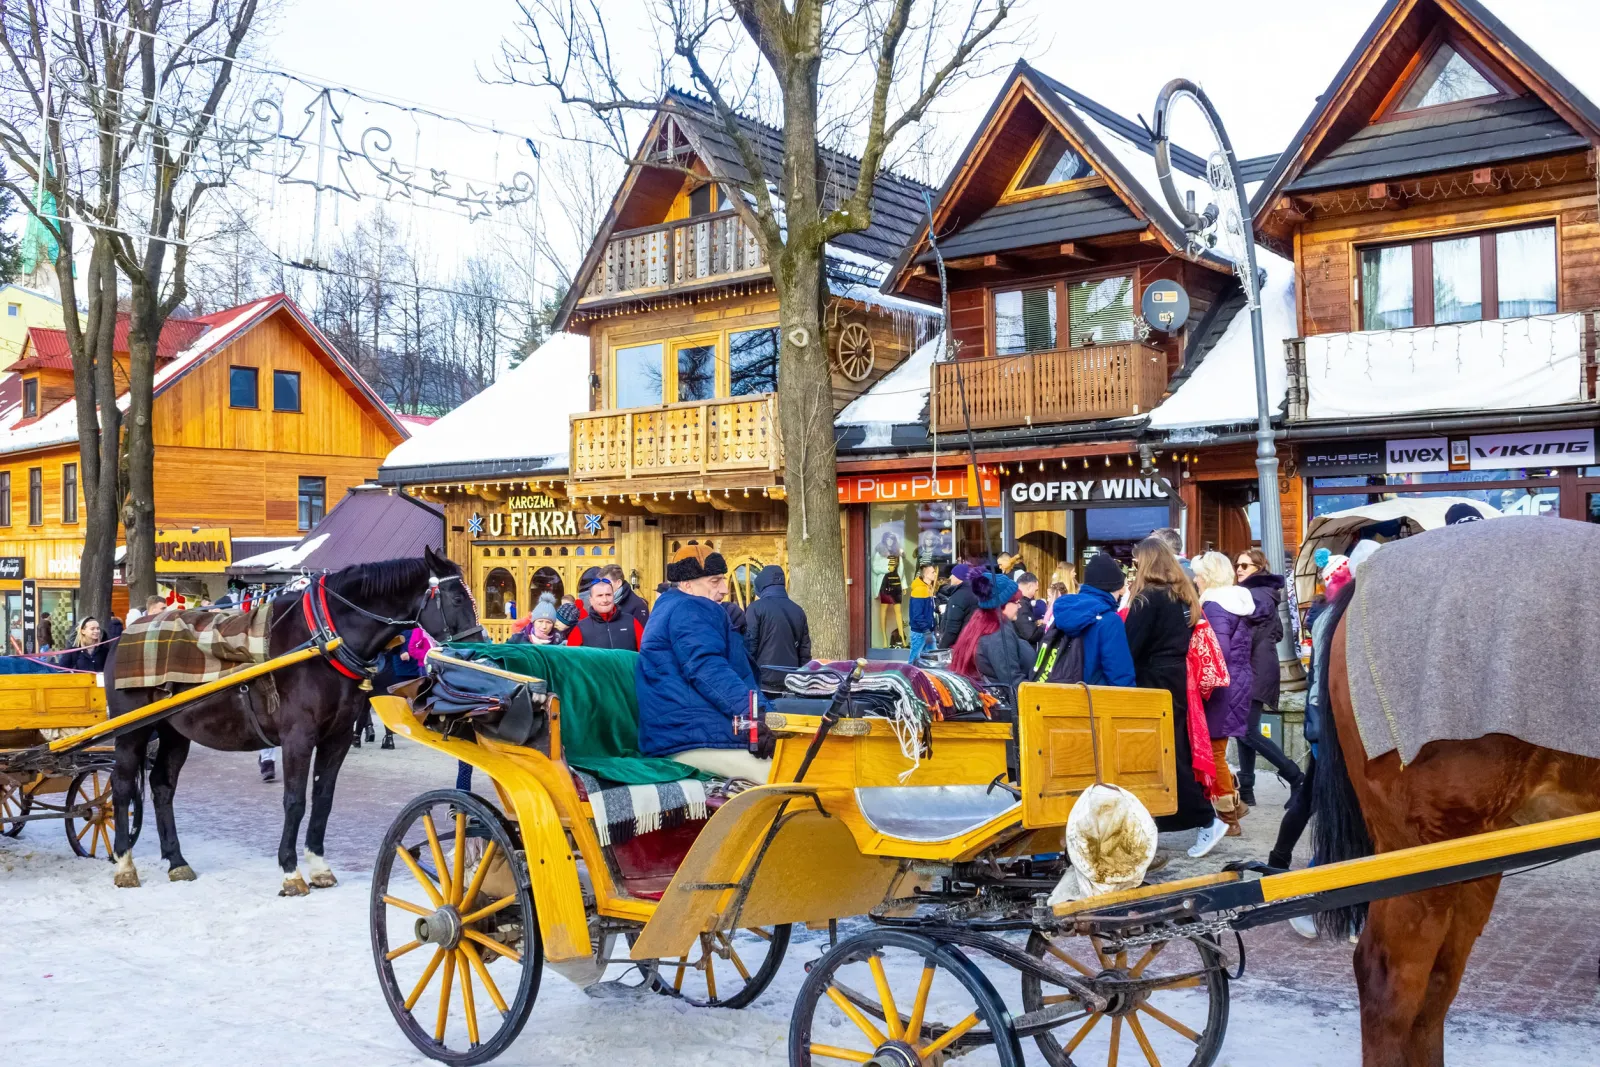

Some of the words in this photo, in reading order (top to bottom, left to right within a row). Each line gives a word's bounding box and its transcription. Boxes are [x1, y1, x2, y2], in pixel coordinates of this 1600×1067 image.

[1390, 447, 1444, 463] uvex
[1475, 441, 1589, 458] VIKING
[858, 478, 896, 500] Piu
[1011, 480, 1094, 502] GOFRY
[508, 495, 555, 509] KARCZMA
[489, 513, 503, 536] U
[510, 511, 577, 536] FIAKRA
